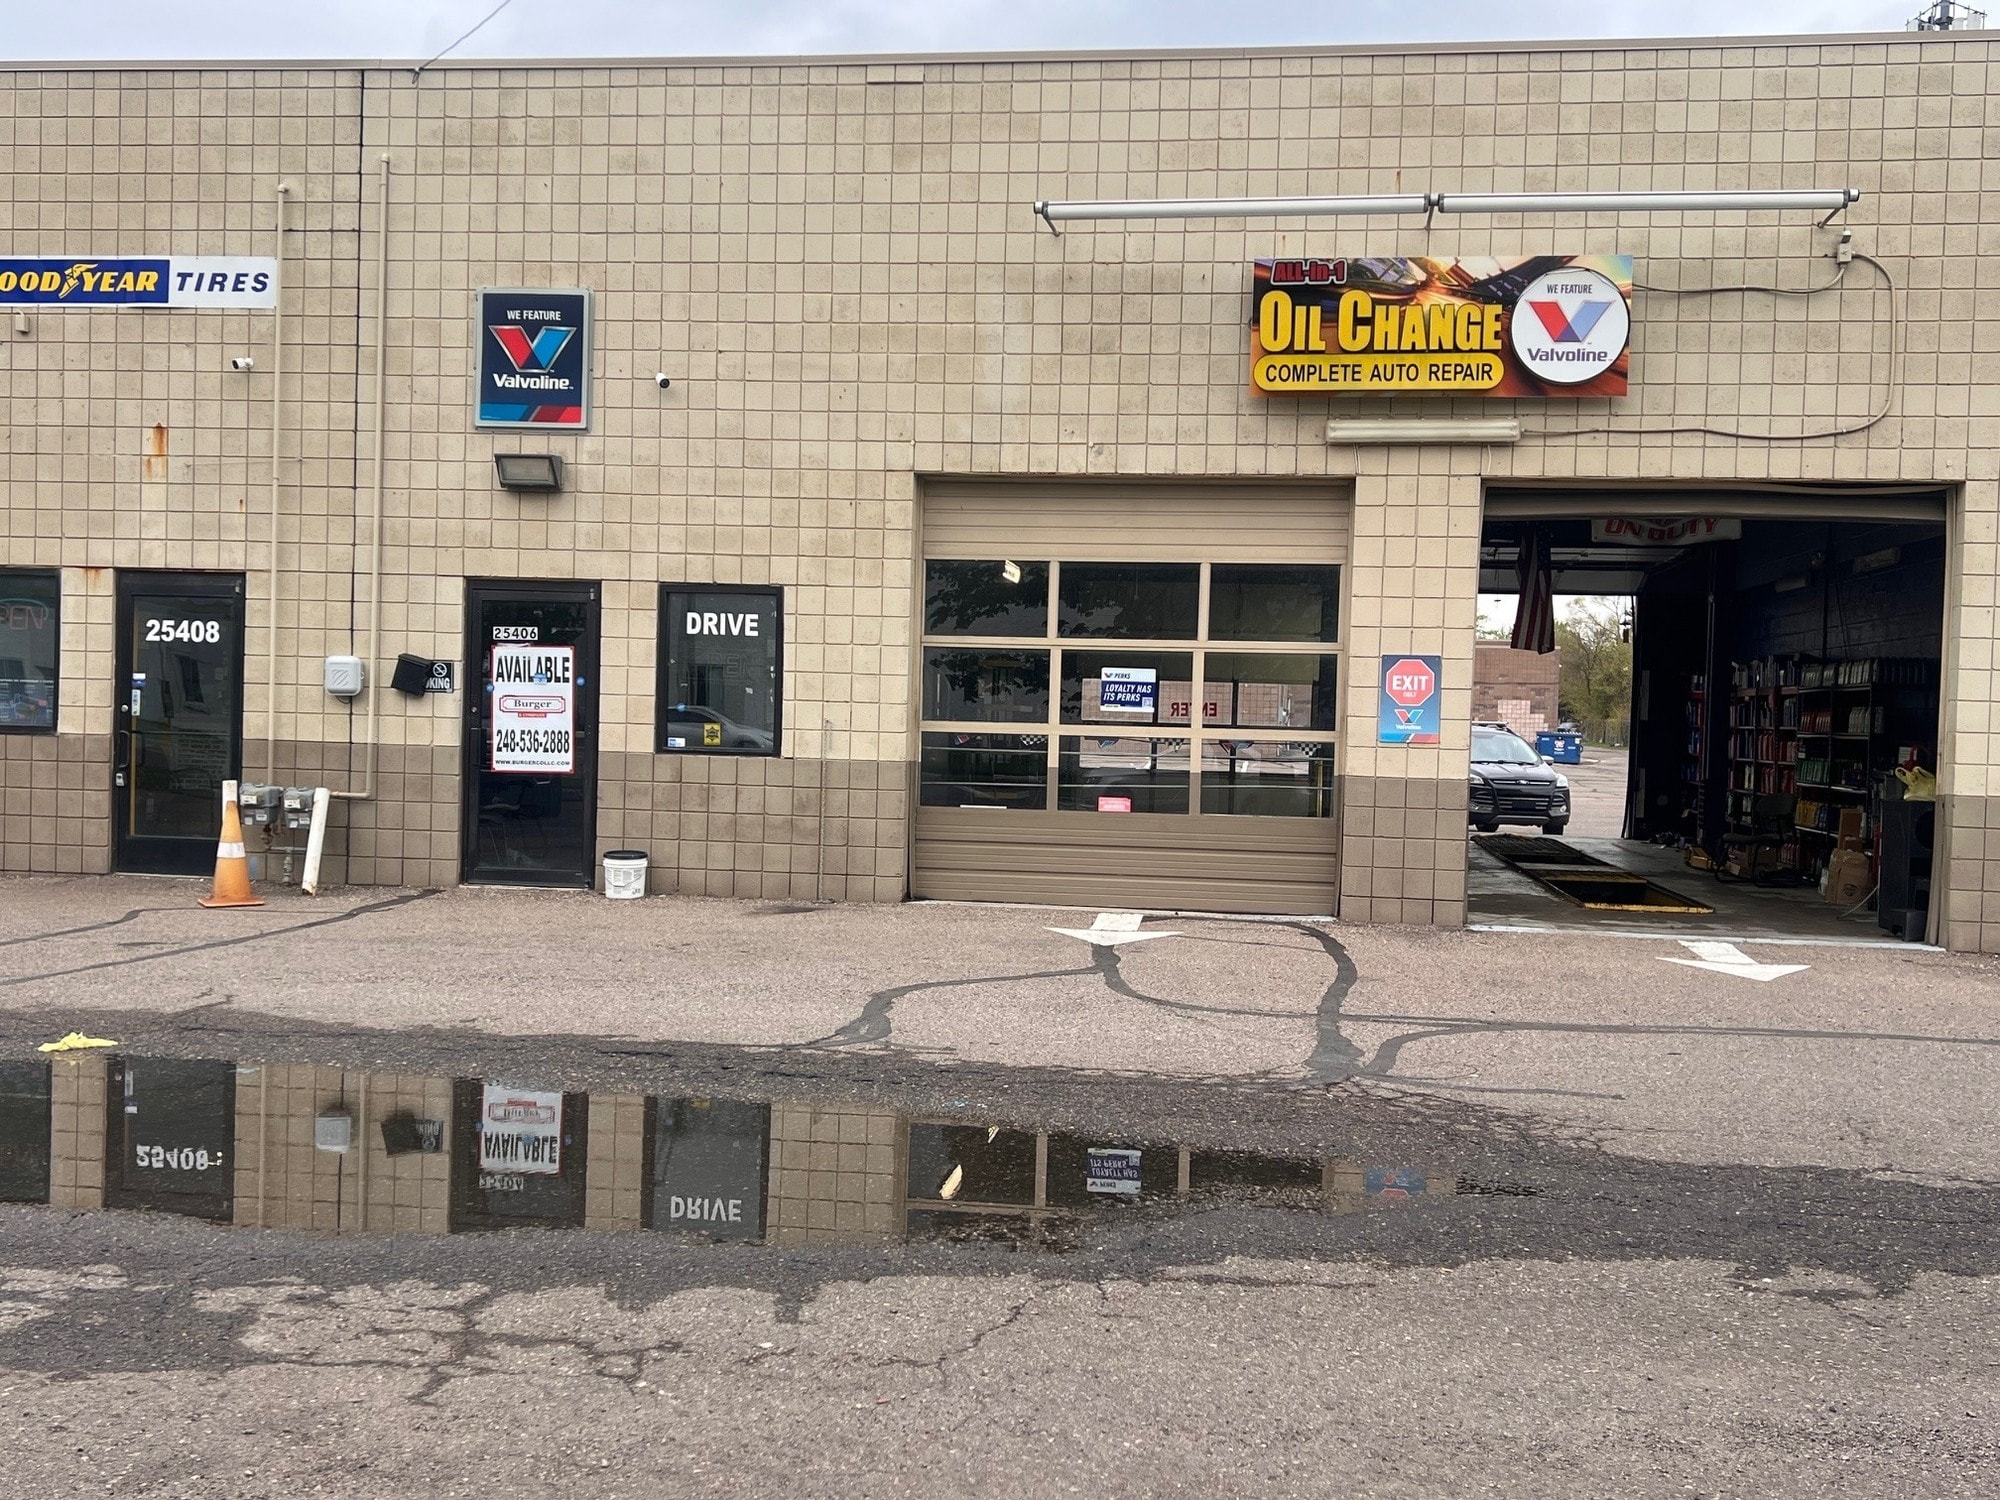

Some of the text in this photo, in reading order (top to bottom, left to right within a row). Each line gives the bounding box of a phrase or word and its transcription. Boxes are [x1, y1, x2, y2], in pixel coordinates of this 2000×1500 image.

[0, 271, 270, 293] OODYEAR TIRES
[1547, 284, 1593, 294] WE FEATURE
[507, 310, 561, 320] WE FEATURE
[1260, 289, 1502, 352] OIL CHANGE
[1527, 348, 1608, 362] Valvoline
[1266, 362, 1493, 382] COMPLETE AUTO REPAIR
[493, 373, 570, 389] Valvoline
[1605, 517, 1641, 536] ON
[145, 619, 220, 643] 25408
[686, 612, 759, 636] DRIVE
[494, 627, 537, 639] 25406
[425, 677, 450, 688] KING
[1105, 684, 1152, 693] LOYALTY HAS
[1392, 675, 1429, 690] EXIT
[1103, 692, 1115, 700] ITS
[514, 699, 552, 709] Burger
[496, 729, 570, 753] 248-536-2888
